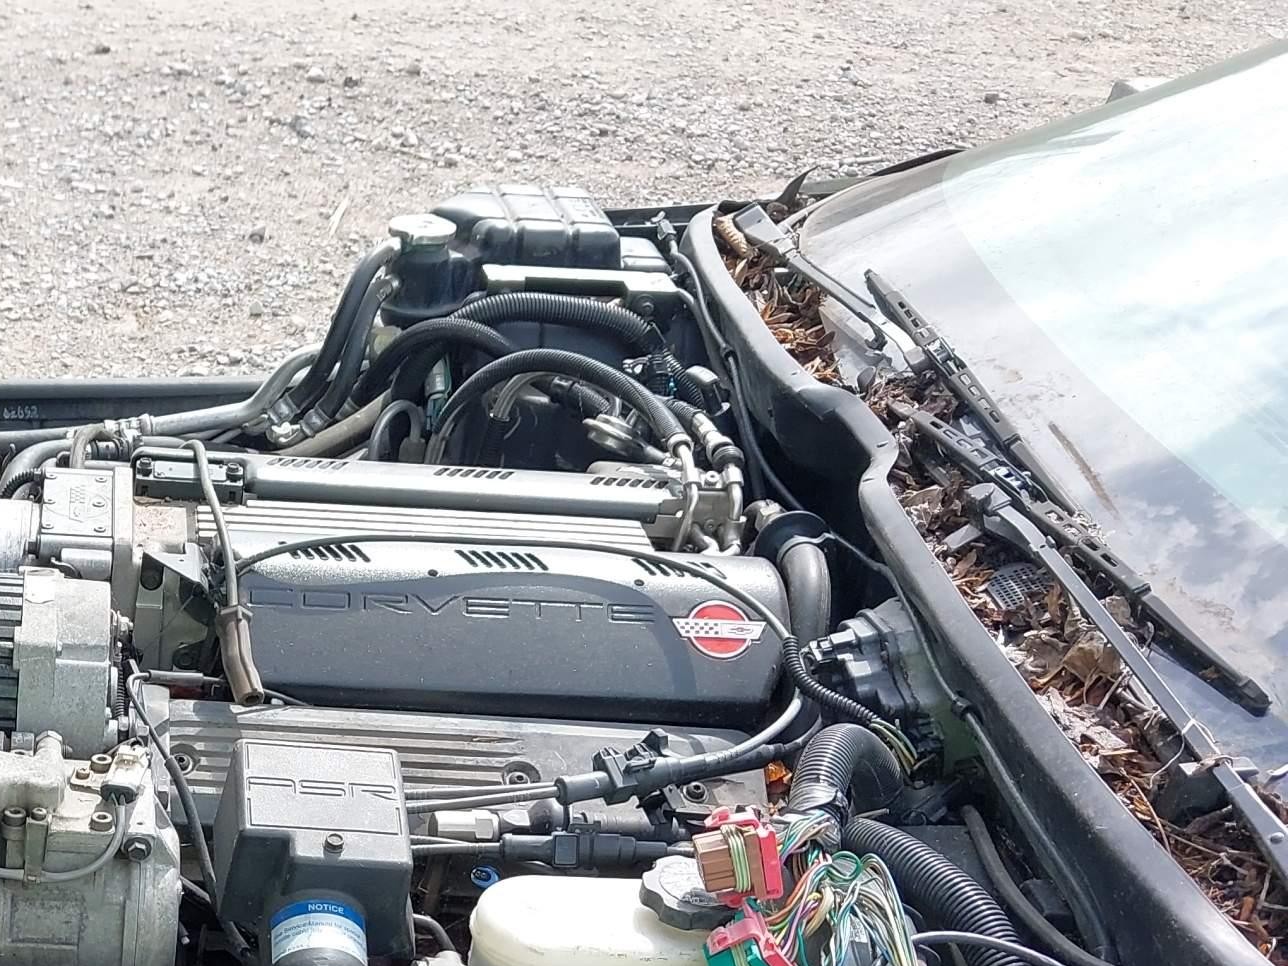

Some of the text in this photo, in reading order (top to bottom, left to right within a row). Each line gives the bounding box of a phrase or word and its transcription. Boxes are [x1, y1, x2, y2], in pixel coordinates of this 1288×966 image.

[247, 587, 655, 624] CORVETTE
[246, 776, 398, 801] ASR
[308, 903, 345, 915] NOTICE
